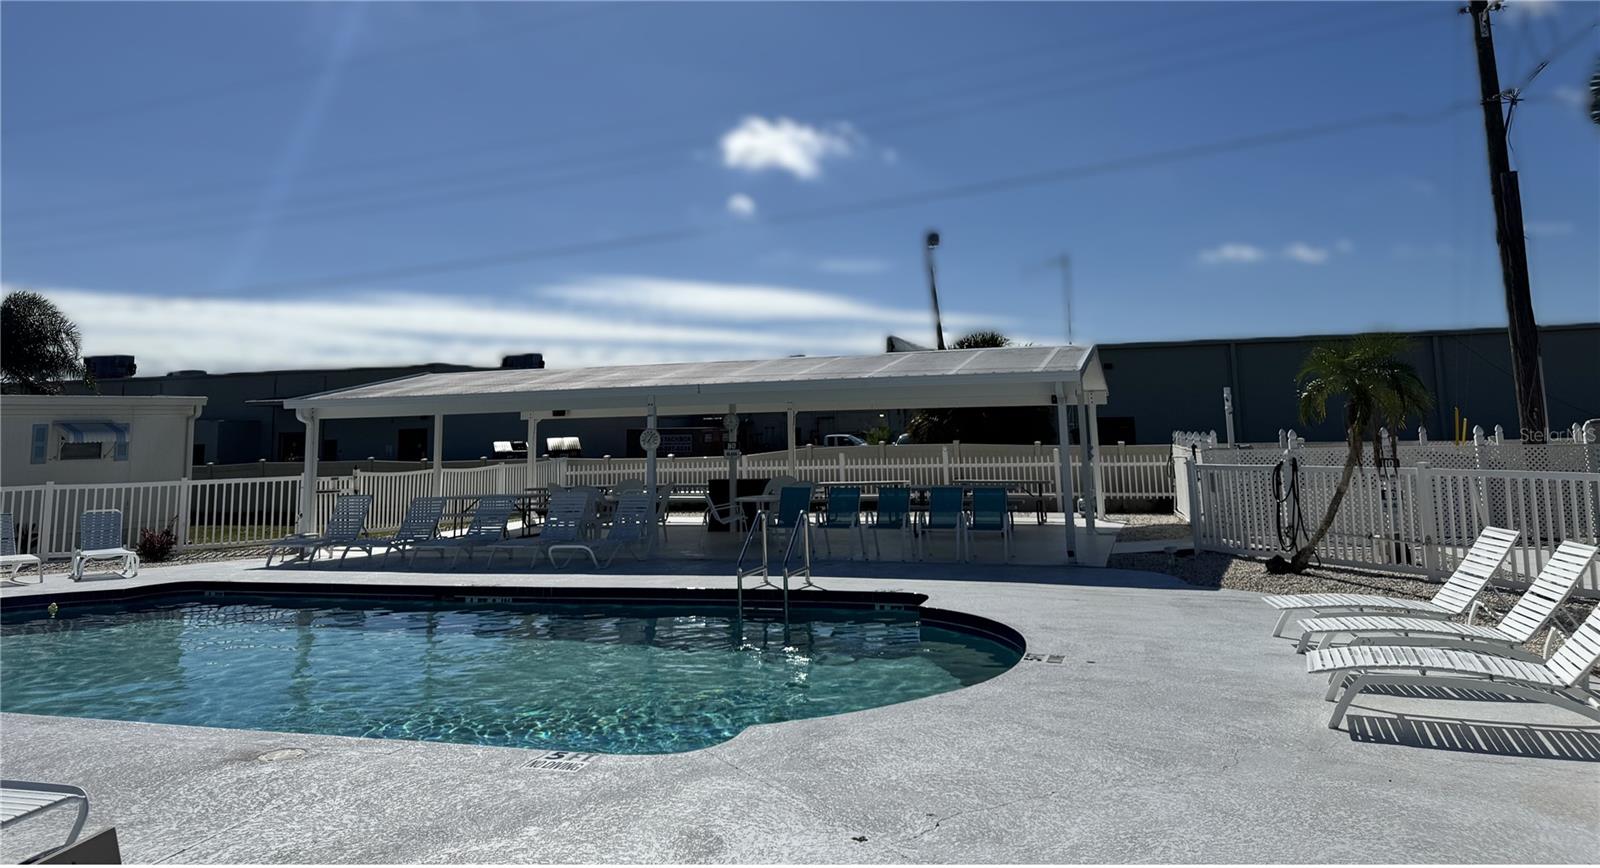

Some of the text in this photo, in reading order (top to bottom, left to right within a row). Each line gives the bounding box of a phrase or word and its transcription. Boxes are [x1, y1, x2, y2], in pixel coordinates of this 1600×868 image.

[545, 751, 569, 760] 5
[525, 760, 585, 771] NO DIVING
